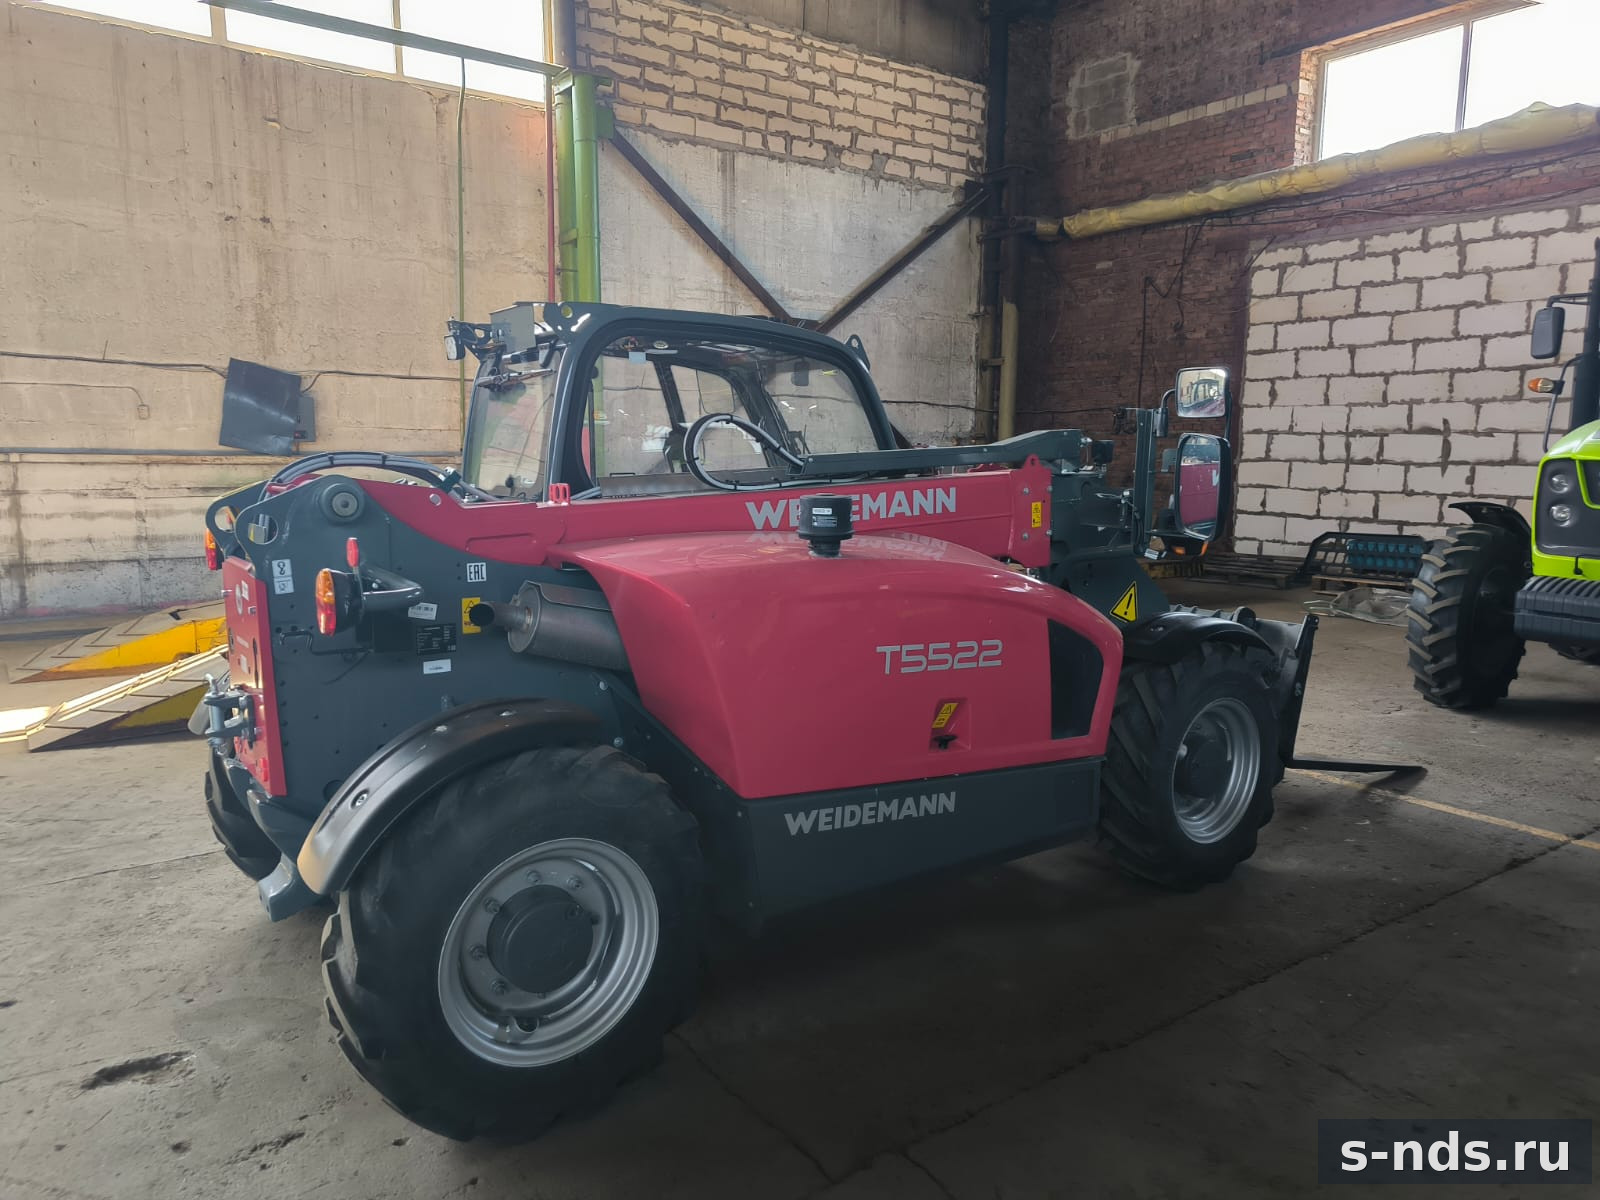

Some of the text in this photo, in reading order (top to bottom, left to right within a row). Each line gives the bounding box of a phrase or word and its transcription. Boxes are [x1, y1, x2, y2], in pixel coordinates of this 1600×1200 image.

[745, 487, 957, 530] WEEMANN
[876, 639, 1003, 675] T5522
[784, 791, 956, 836] WEIDEMANN
